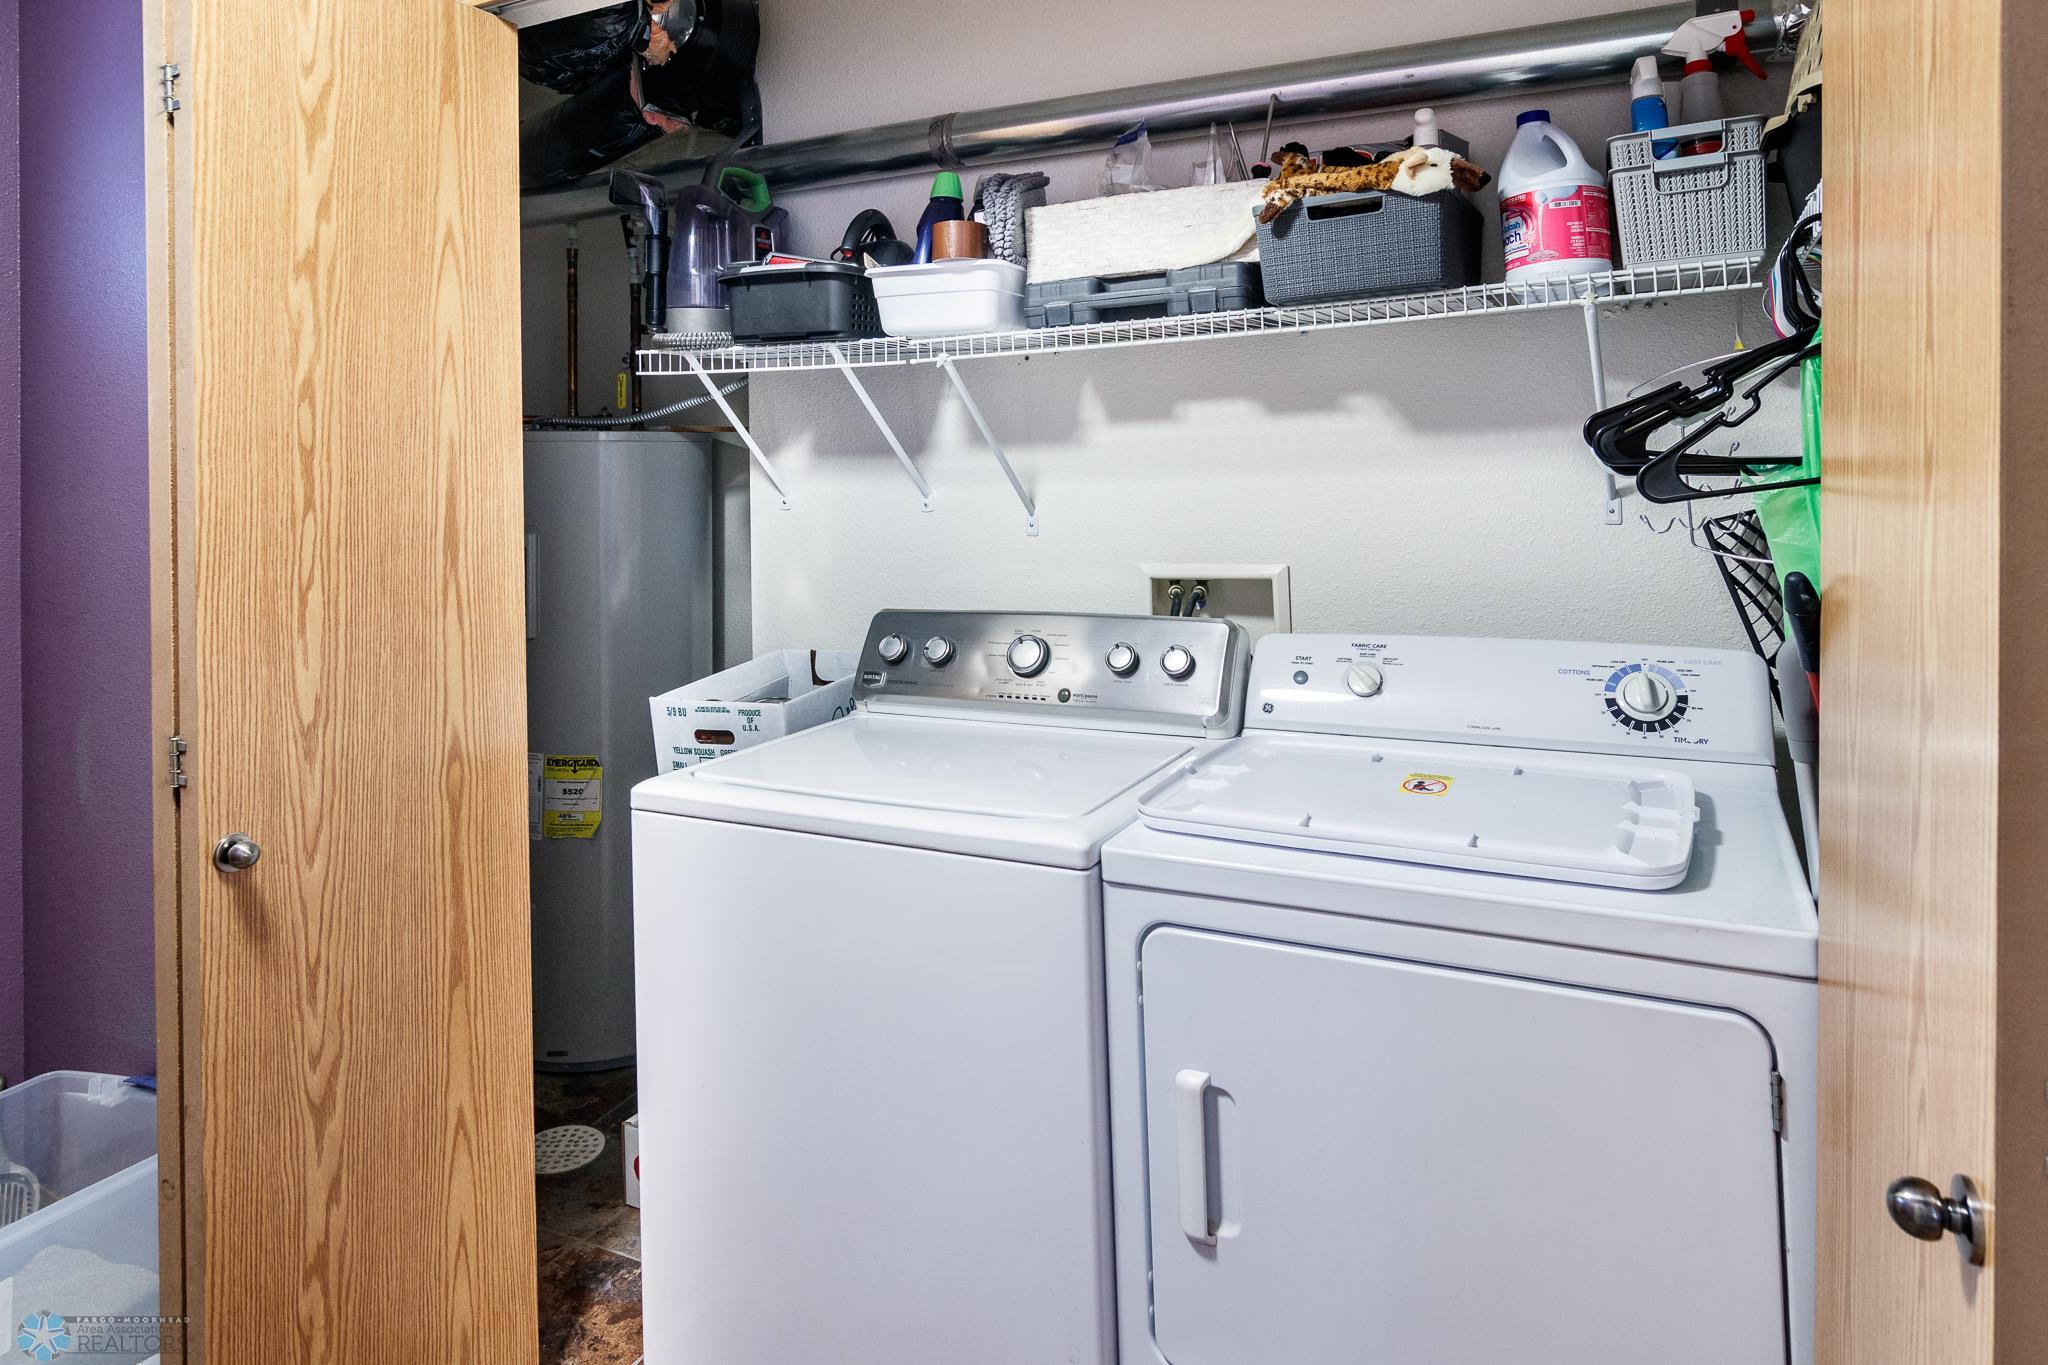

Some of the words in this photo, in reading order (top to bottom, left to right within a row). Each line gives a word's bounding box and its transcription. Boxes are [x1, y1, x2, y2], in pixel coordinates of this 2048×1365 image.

[1503, 231, 1522, 247] ach
[738, 709, 762, 717] PRODUCE
[1673, 736, 1692, 744] TIM
[672, 746, 693, 755] YELLOW
[694, 747, 716, 757] SQUASH
[562, 787, 584, 796] $520
